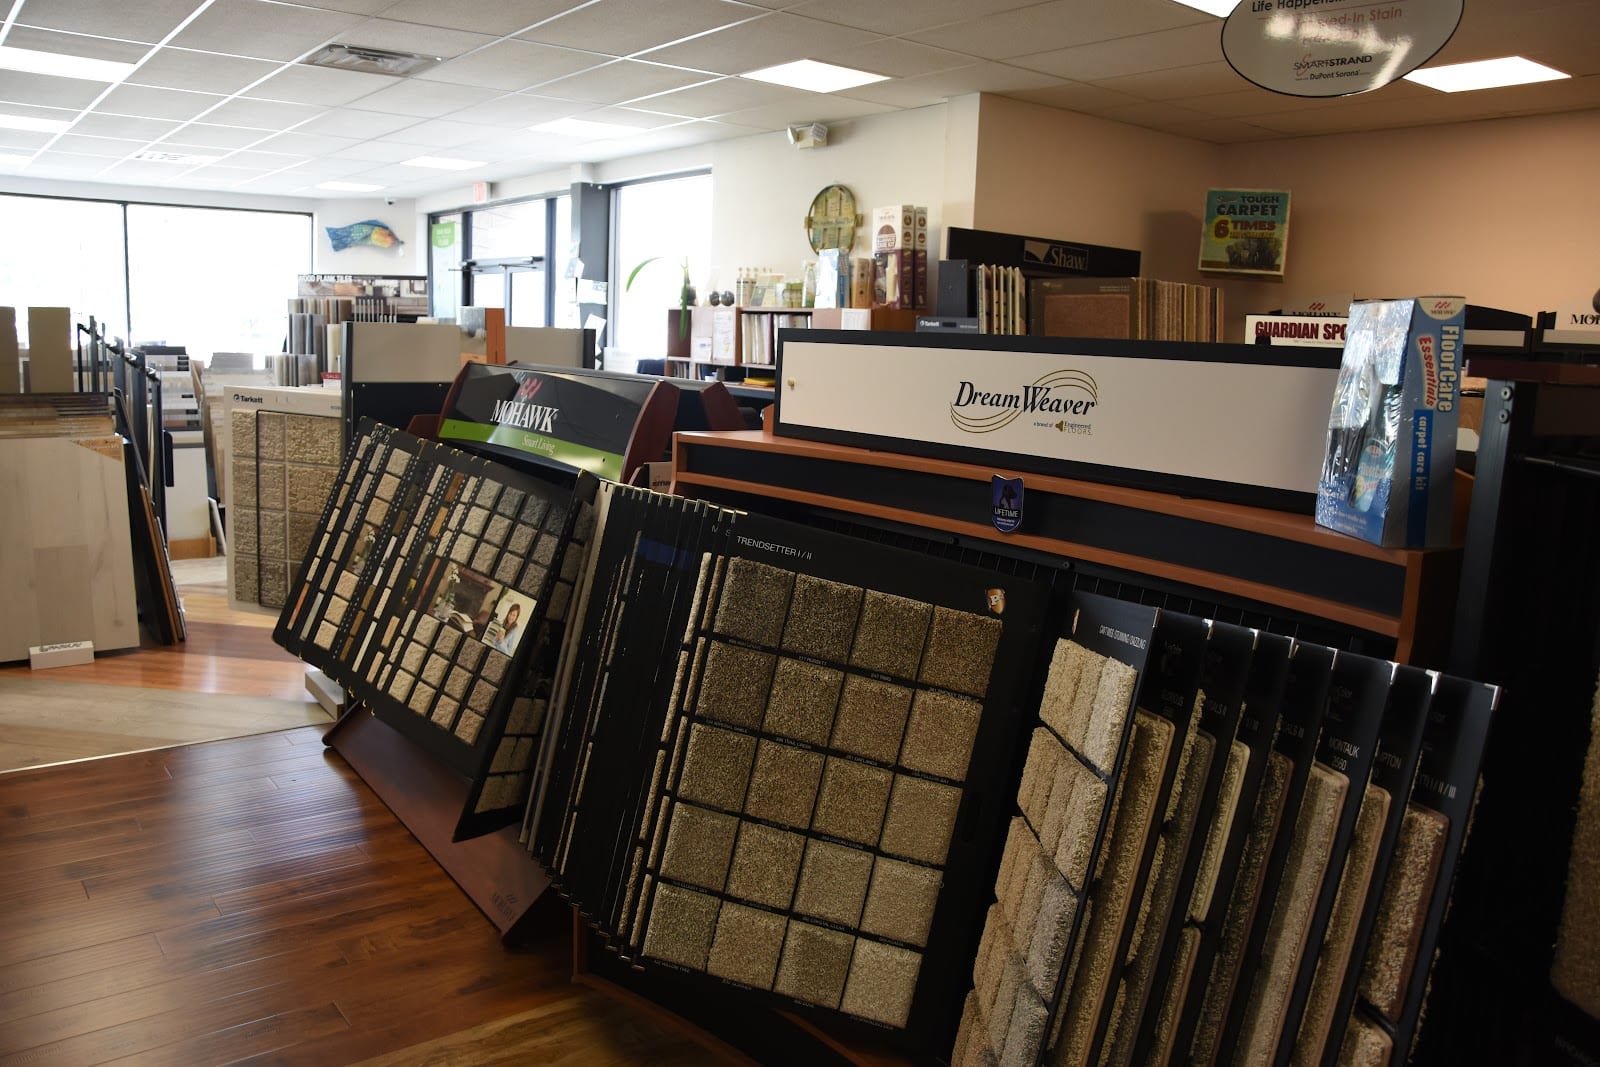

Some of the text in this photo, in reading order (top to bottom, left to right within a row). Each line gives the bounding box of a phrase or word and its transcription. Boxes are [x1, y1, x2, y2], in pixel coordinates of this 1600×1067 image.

[1252, 0, 1273, 13] Life
[1369, 6, 1402, 21] Stain
[1309, 71, 1334, 81] DuPont
[1240, 195, 1279, 204] TOUGH
[1216, 204, 1279, 216] CARPET
[1214, 219, 1229, 238] 6
[1231, 220, 1277, 231] TIMES
[1051, 247, 1087, 272] Shaw
[1255, 320, 1319, 340] GUARDIAN
[1418, 335, 1437, 407] Essentials
[1437, 324, 1460, 412] FloorCare
[240, 394, 263, 404] Tarkett
[490, 399, 560, 433] MOHAWK
[522, 434, 556, 455] Smart Living
[1415, 415, 1429, 491] carpet care kit
[994, 507, 1019, 518] LIFETIME
[736, 535, 797, 557] TRENDSETTER
